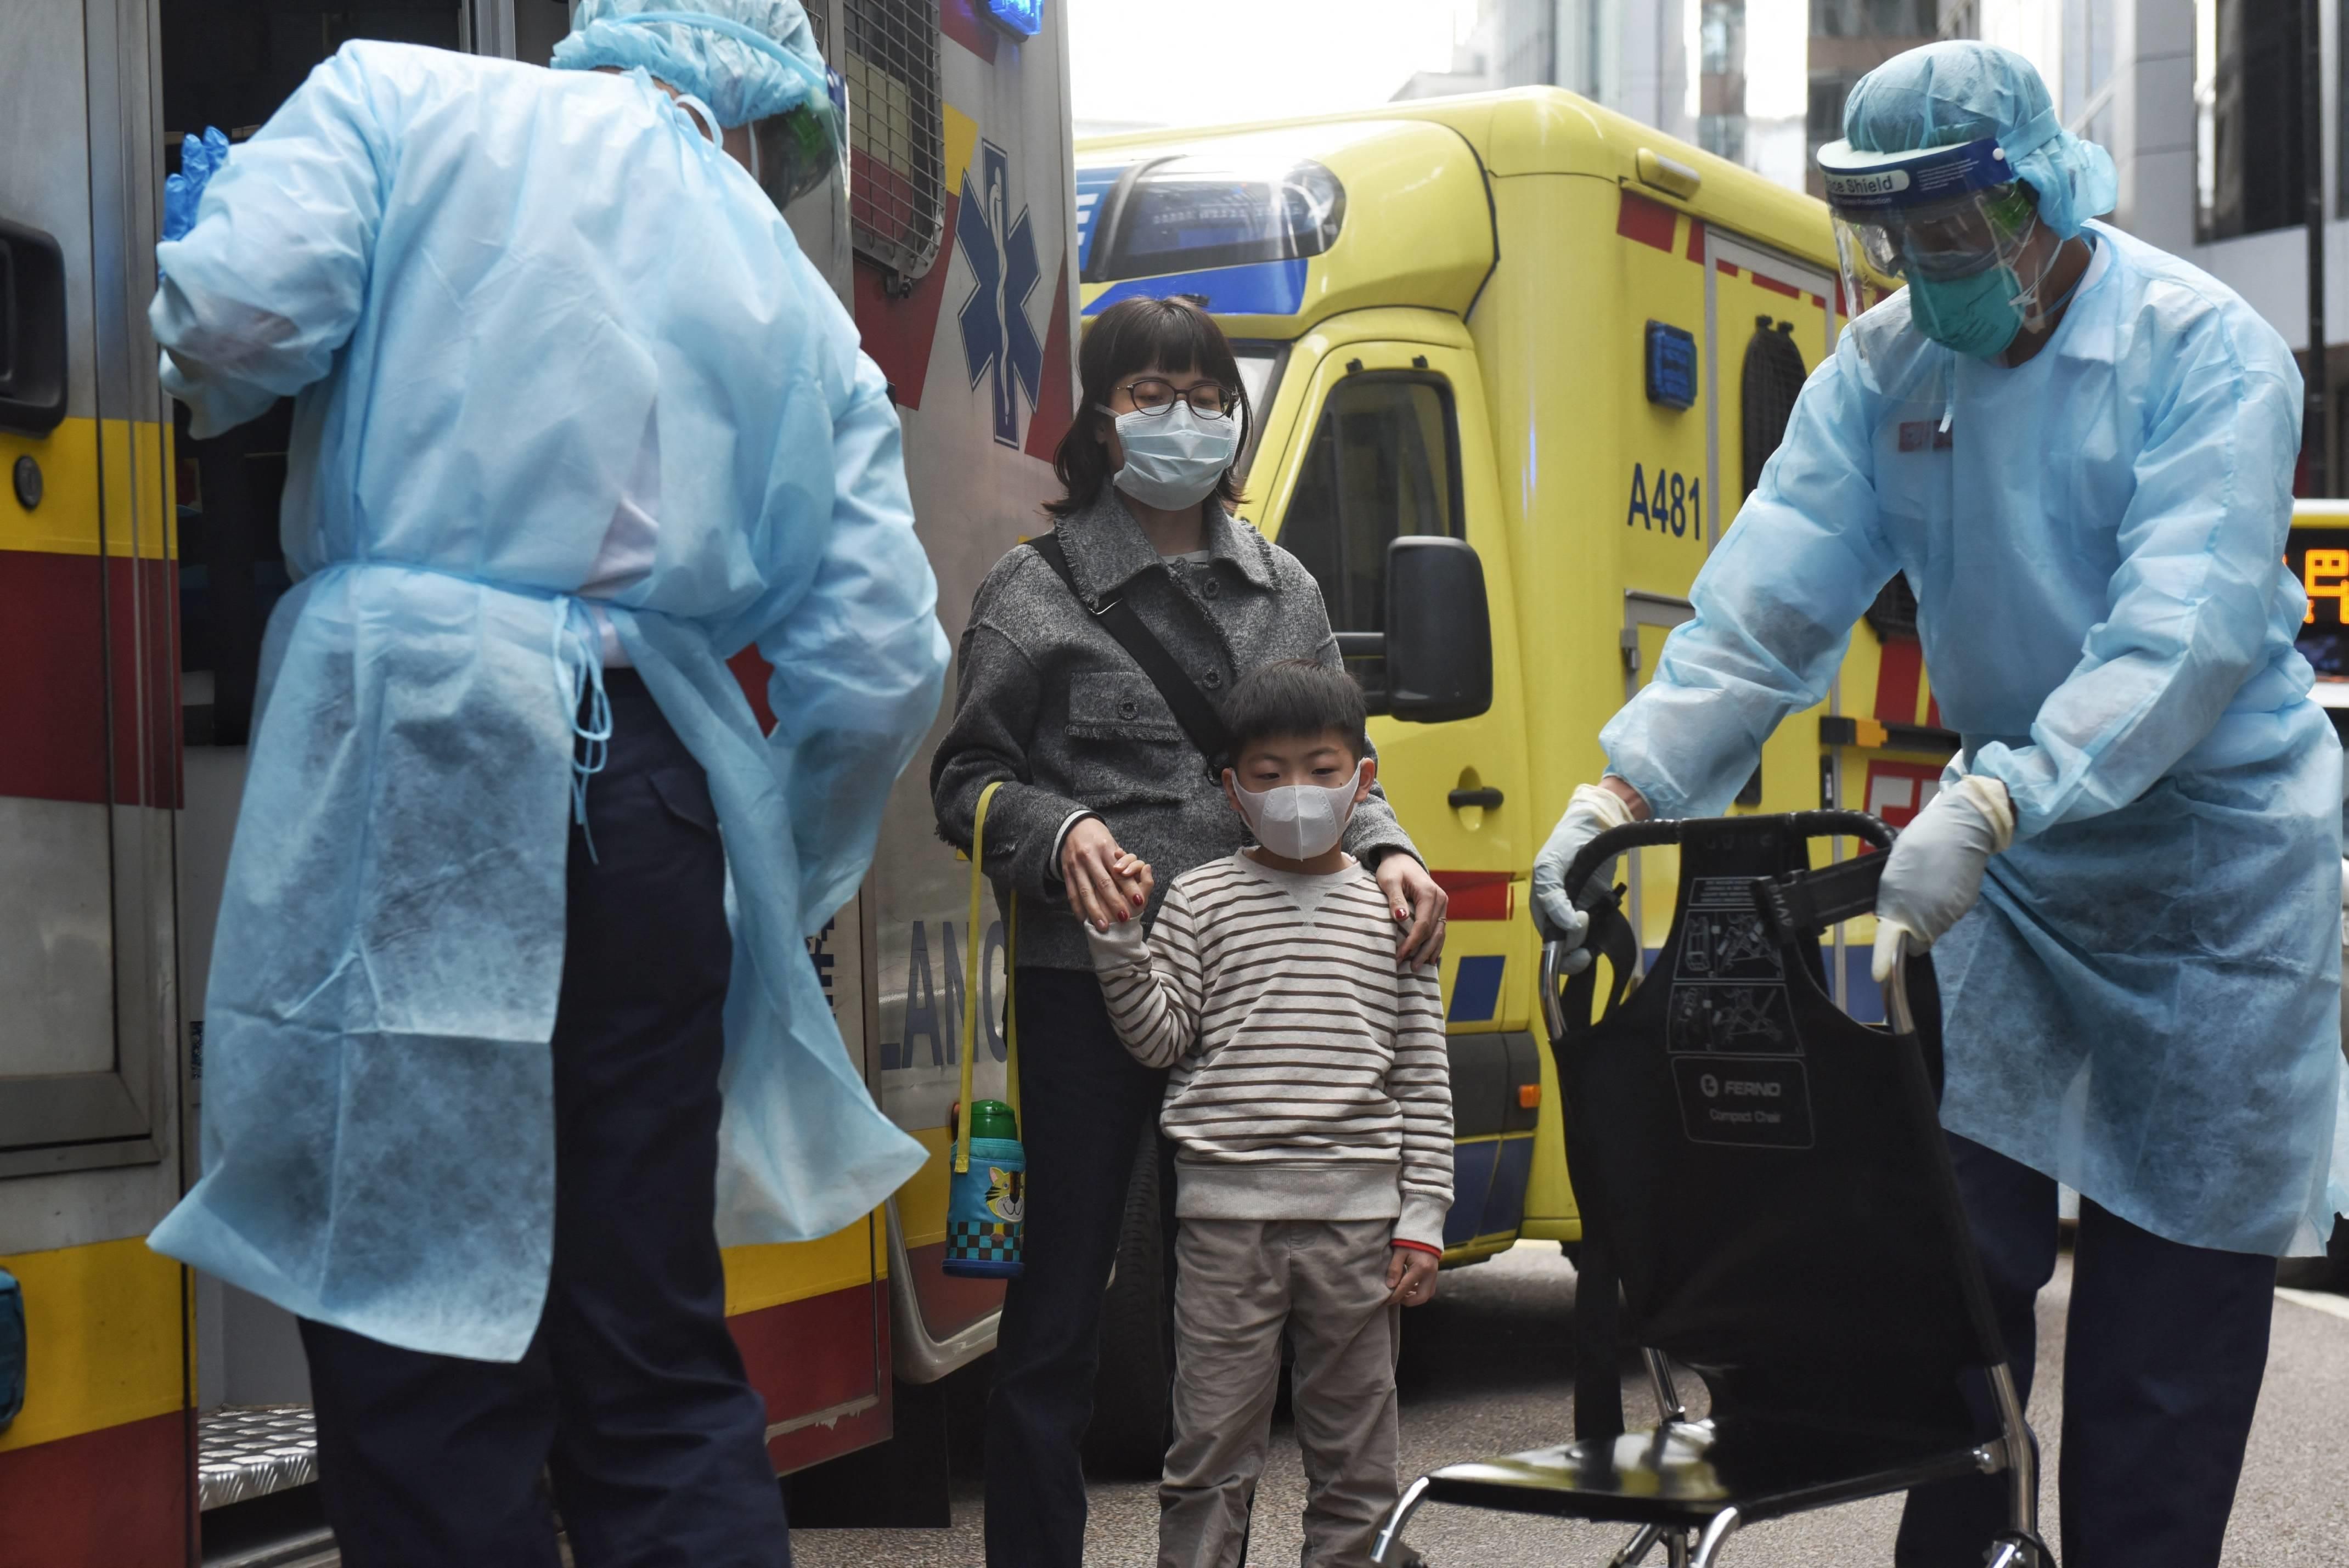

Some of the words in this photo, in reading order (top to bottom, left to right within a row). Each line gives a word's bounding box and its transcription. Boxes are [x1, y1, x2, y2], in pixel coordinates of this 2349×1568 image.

[1846, 175, 1893, 194] Shield
[1627, 462, 1700, 542] A481
[1725, 1080, 1781, 1097] FERNO
